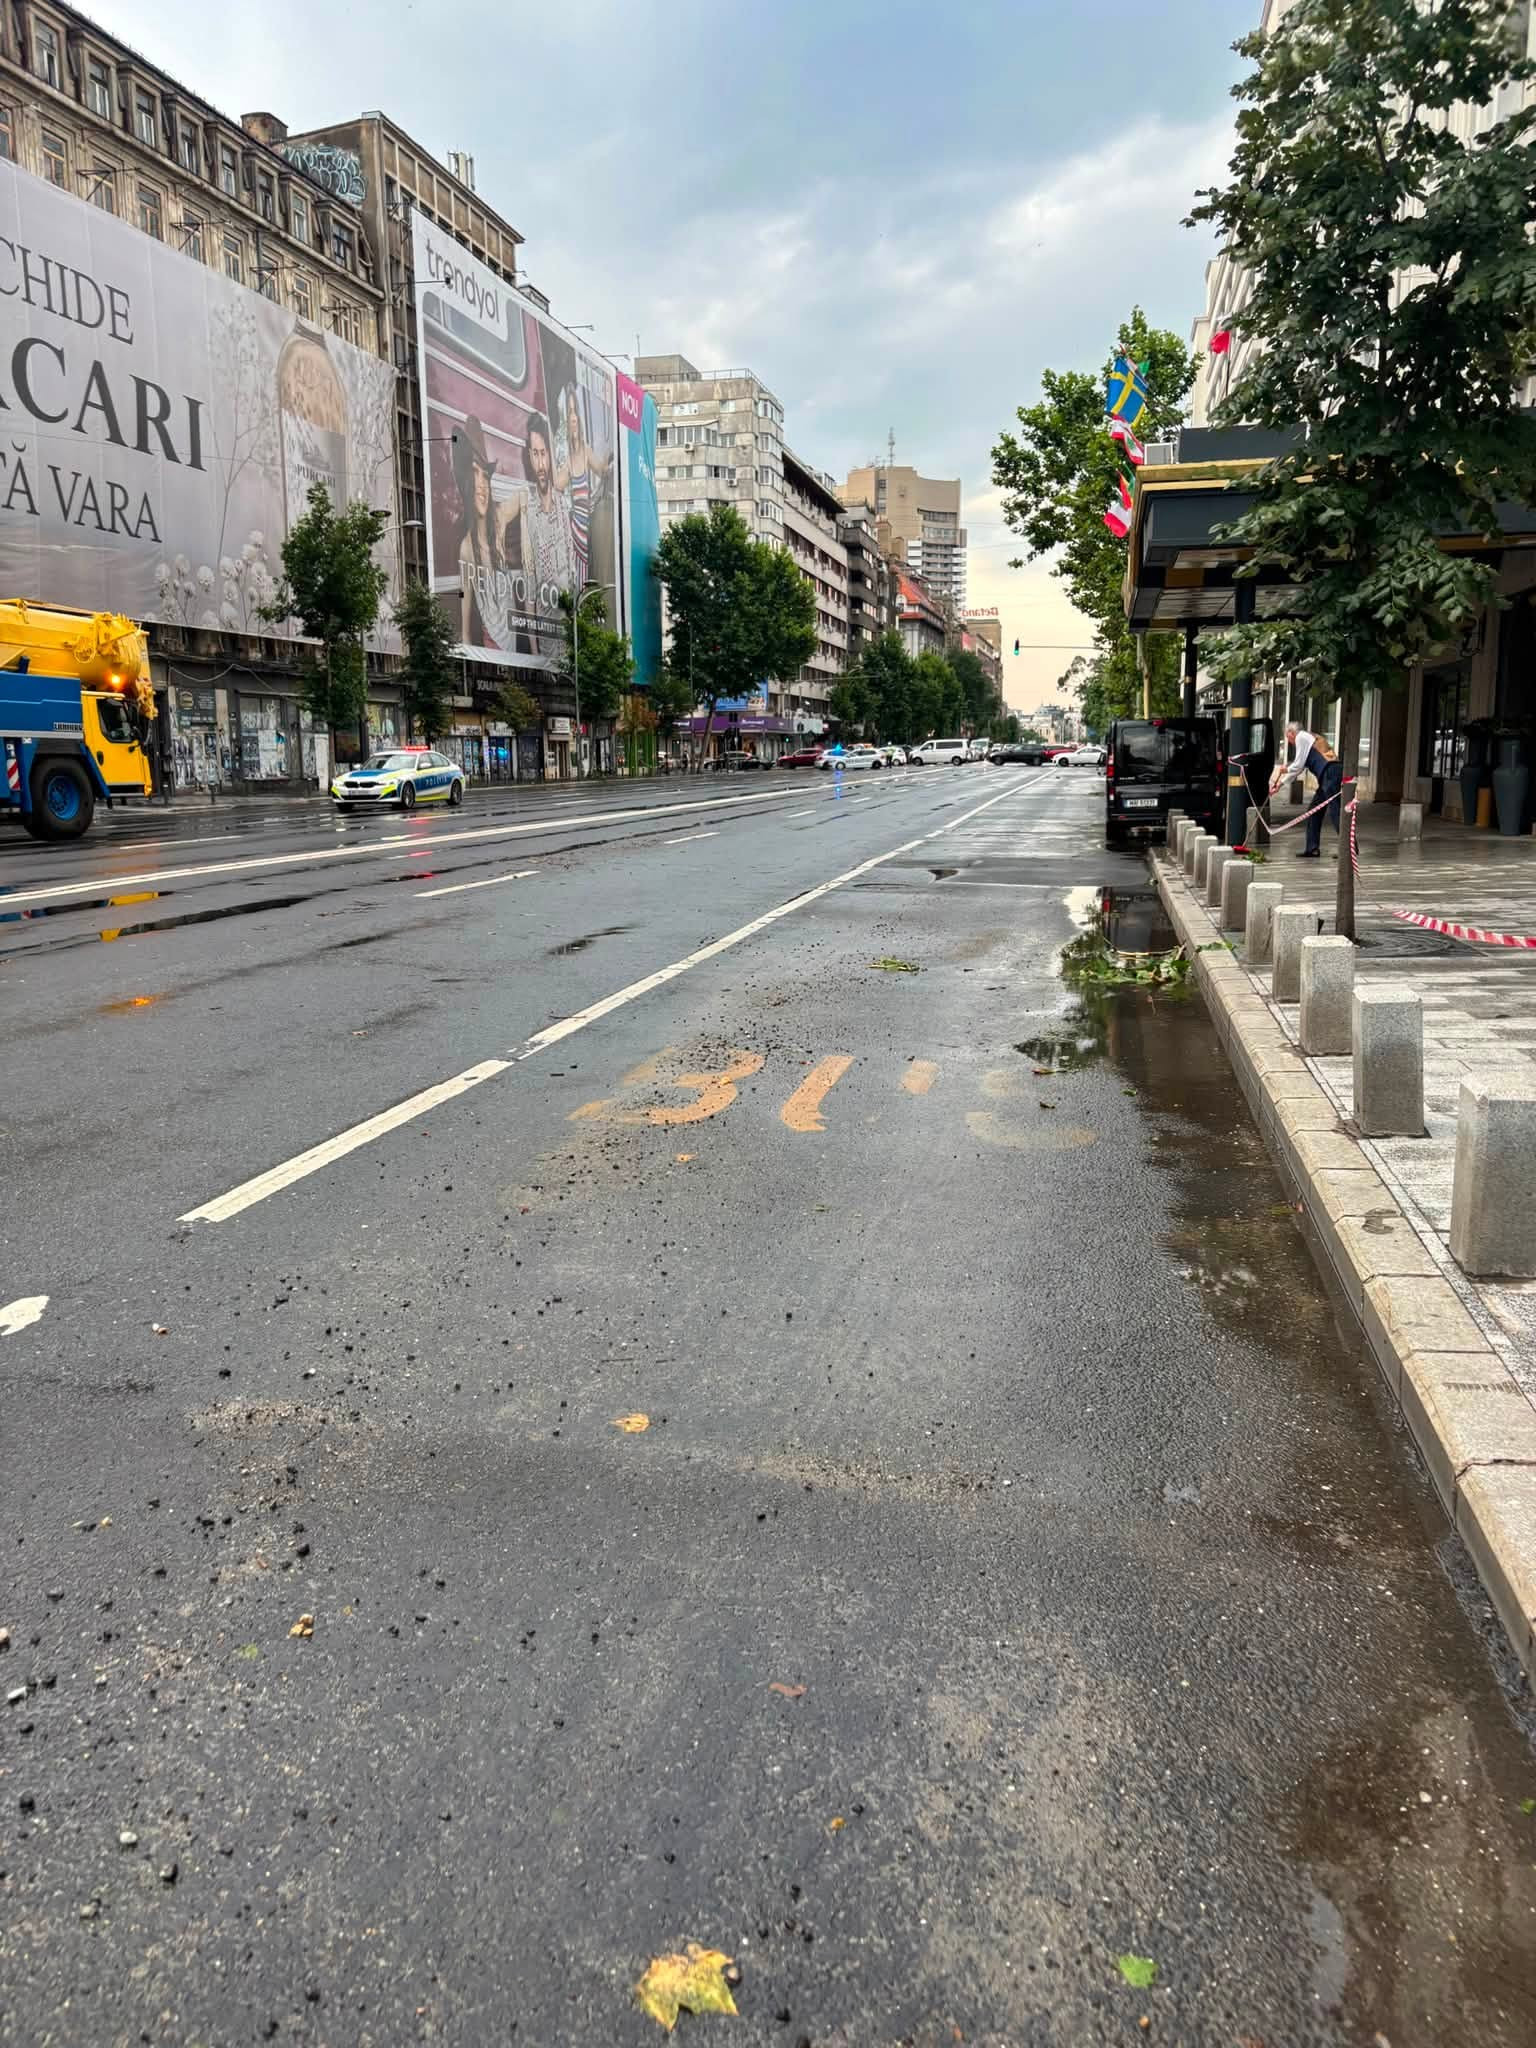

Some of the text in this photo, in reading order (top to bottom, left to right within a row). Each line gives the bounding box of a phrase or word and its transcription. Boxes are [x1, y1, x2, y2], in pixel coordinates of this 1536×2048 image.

[425, 237, 500, 324] trendyol
[0, 336, 208, 473] CARI
[620, 389, 640, 419] NOU
[47, 464, 163, 544] VARA
